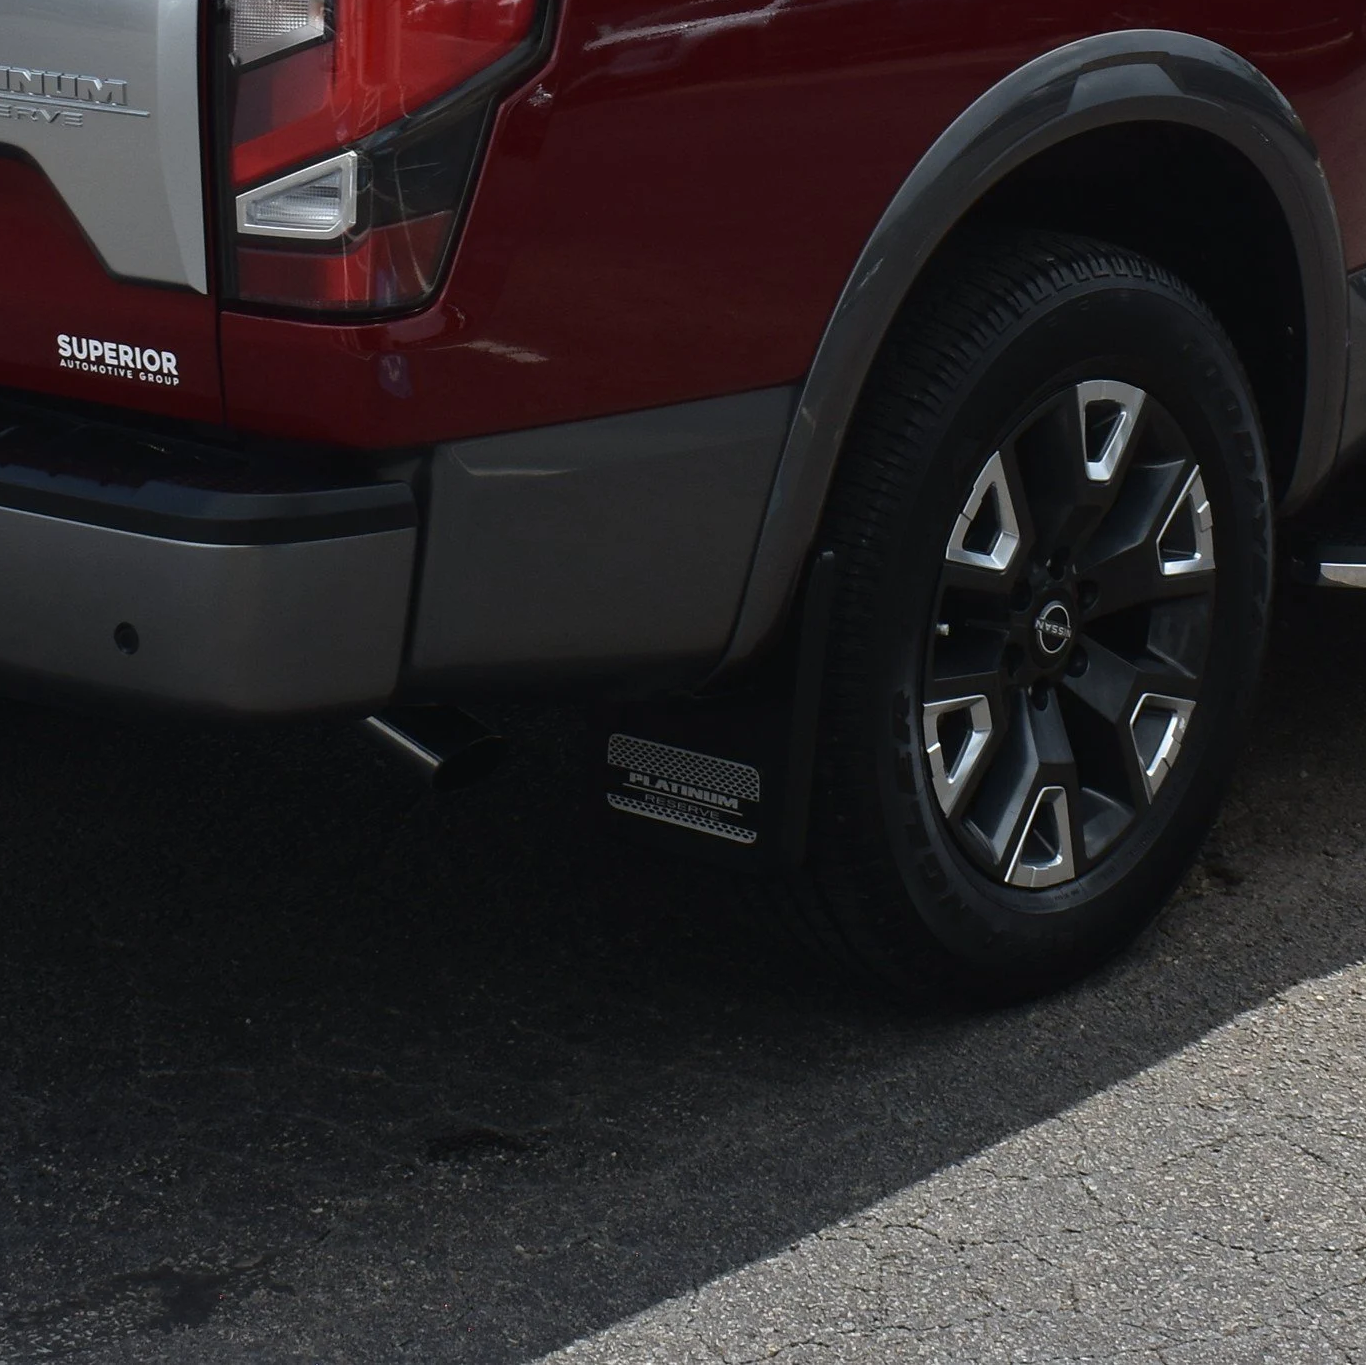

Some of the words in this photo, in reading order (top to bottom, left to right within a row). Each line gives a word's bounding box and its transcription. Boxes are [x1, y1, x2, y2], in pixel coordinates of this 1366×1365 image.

[56, 333, 180, 376] SUPERIOR
[59, 358, 134, 379] AUTOMOTIVE
[139, 372, 180, 387] GROUP
[1035, 619, 1073, 639] NISSAN
[629, 771, 739, 810] PLATINUM
[644, 793, 721, 820] RESERVE
